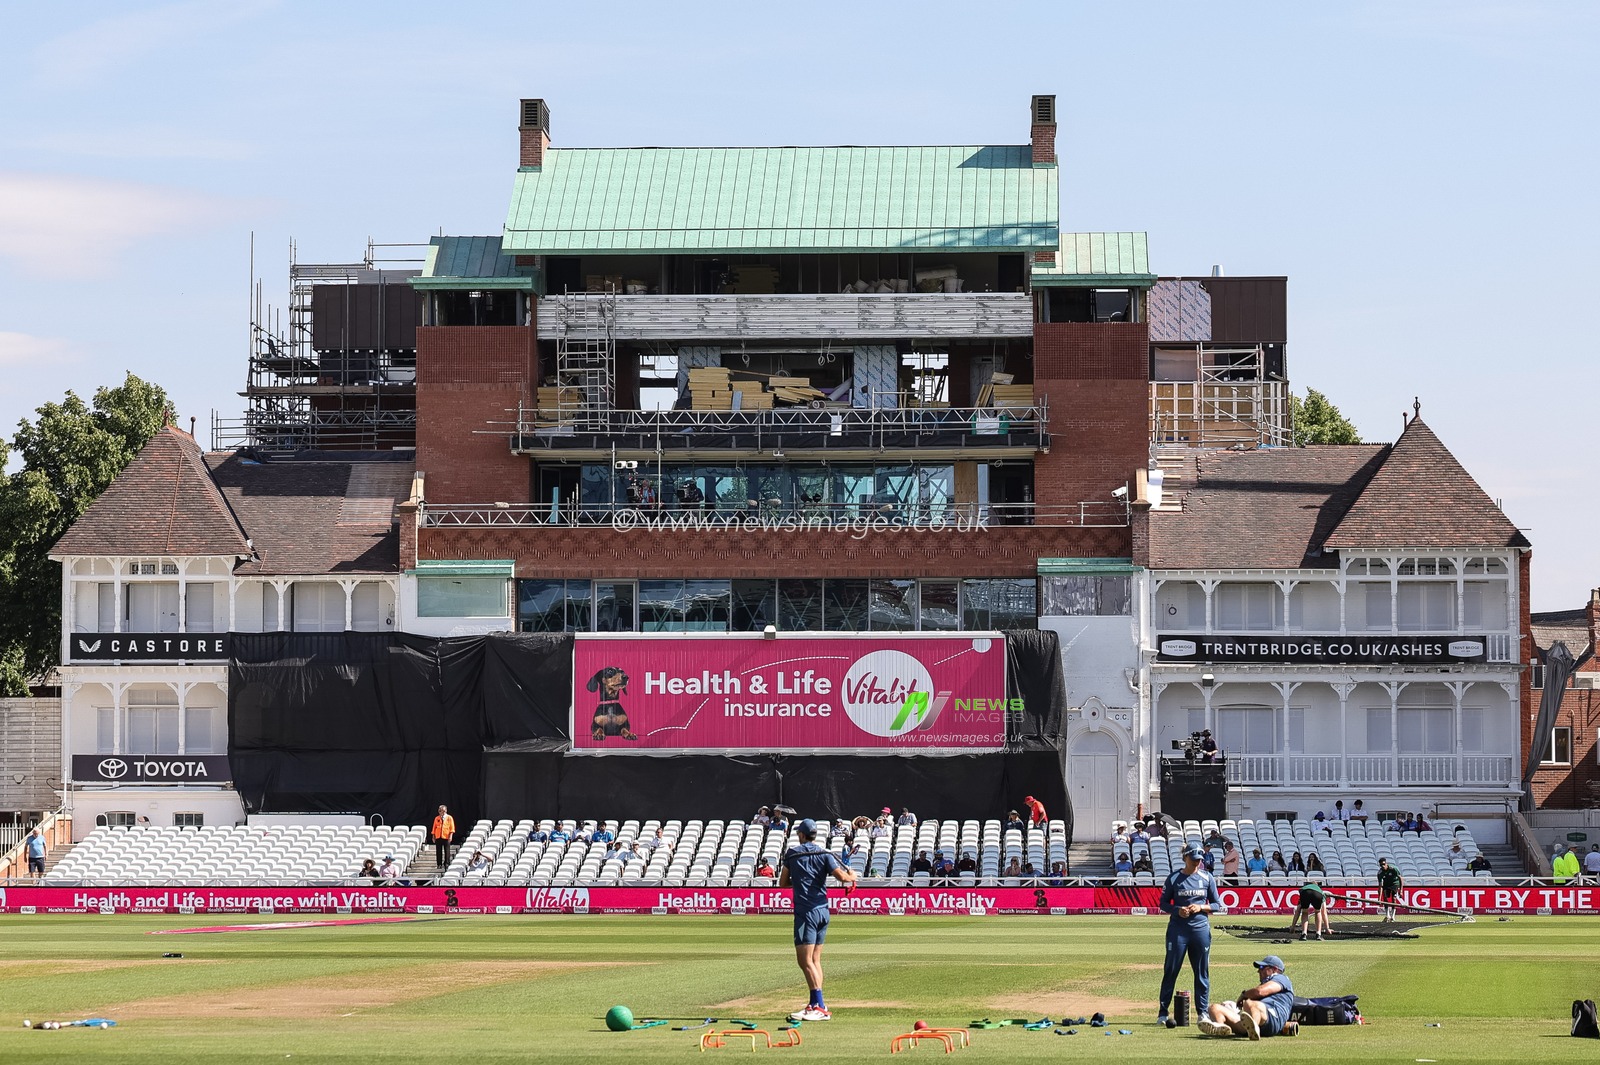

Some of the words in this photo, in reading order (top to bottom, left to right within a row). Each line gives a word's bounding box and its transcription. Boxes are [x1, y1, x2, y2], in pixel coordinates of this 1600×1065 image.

[111, 639, 224, 653] CASTORE
[1202, 642, 1442, 656] TRENTBRIDGE.CO.UK/ASHES
[645, 670, 742, 695] Health
[750, 673, 769, 695] &
[777, 670, 832, 695] Life
[724, 696, 832, 718] insurance
[133, 761, 208, 777] TOYOTA
[74, 892, 130, 908] Health
[135, 892, 169, 908] and
[173, 892, 205, 908] Life
[209, 892, 294, 908] insurance
[298, 892, 339, 908] with
[342, 892, 408, 908] Vitality
[529, 888, 587, 908] Vitality
[658, 892, 717, 908] Health
[720, 892, 756, 908] and
[759, 892, 792, 908] Life
[885, 892, 926, 908] with
[929, 892, 996, 908] Vitality
[1249, 890, 1335, 909] AVOD
[1345, 890, 1431, 909] BENG
[1441, 890, 1486, 909] HIT
[1494, 890, 1530, 909] BY
[1539, 890, 1592, 909] THE
